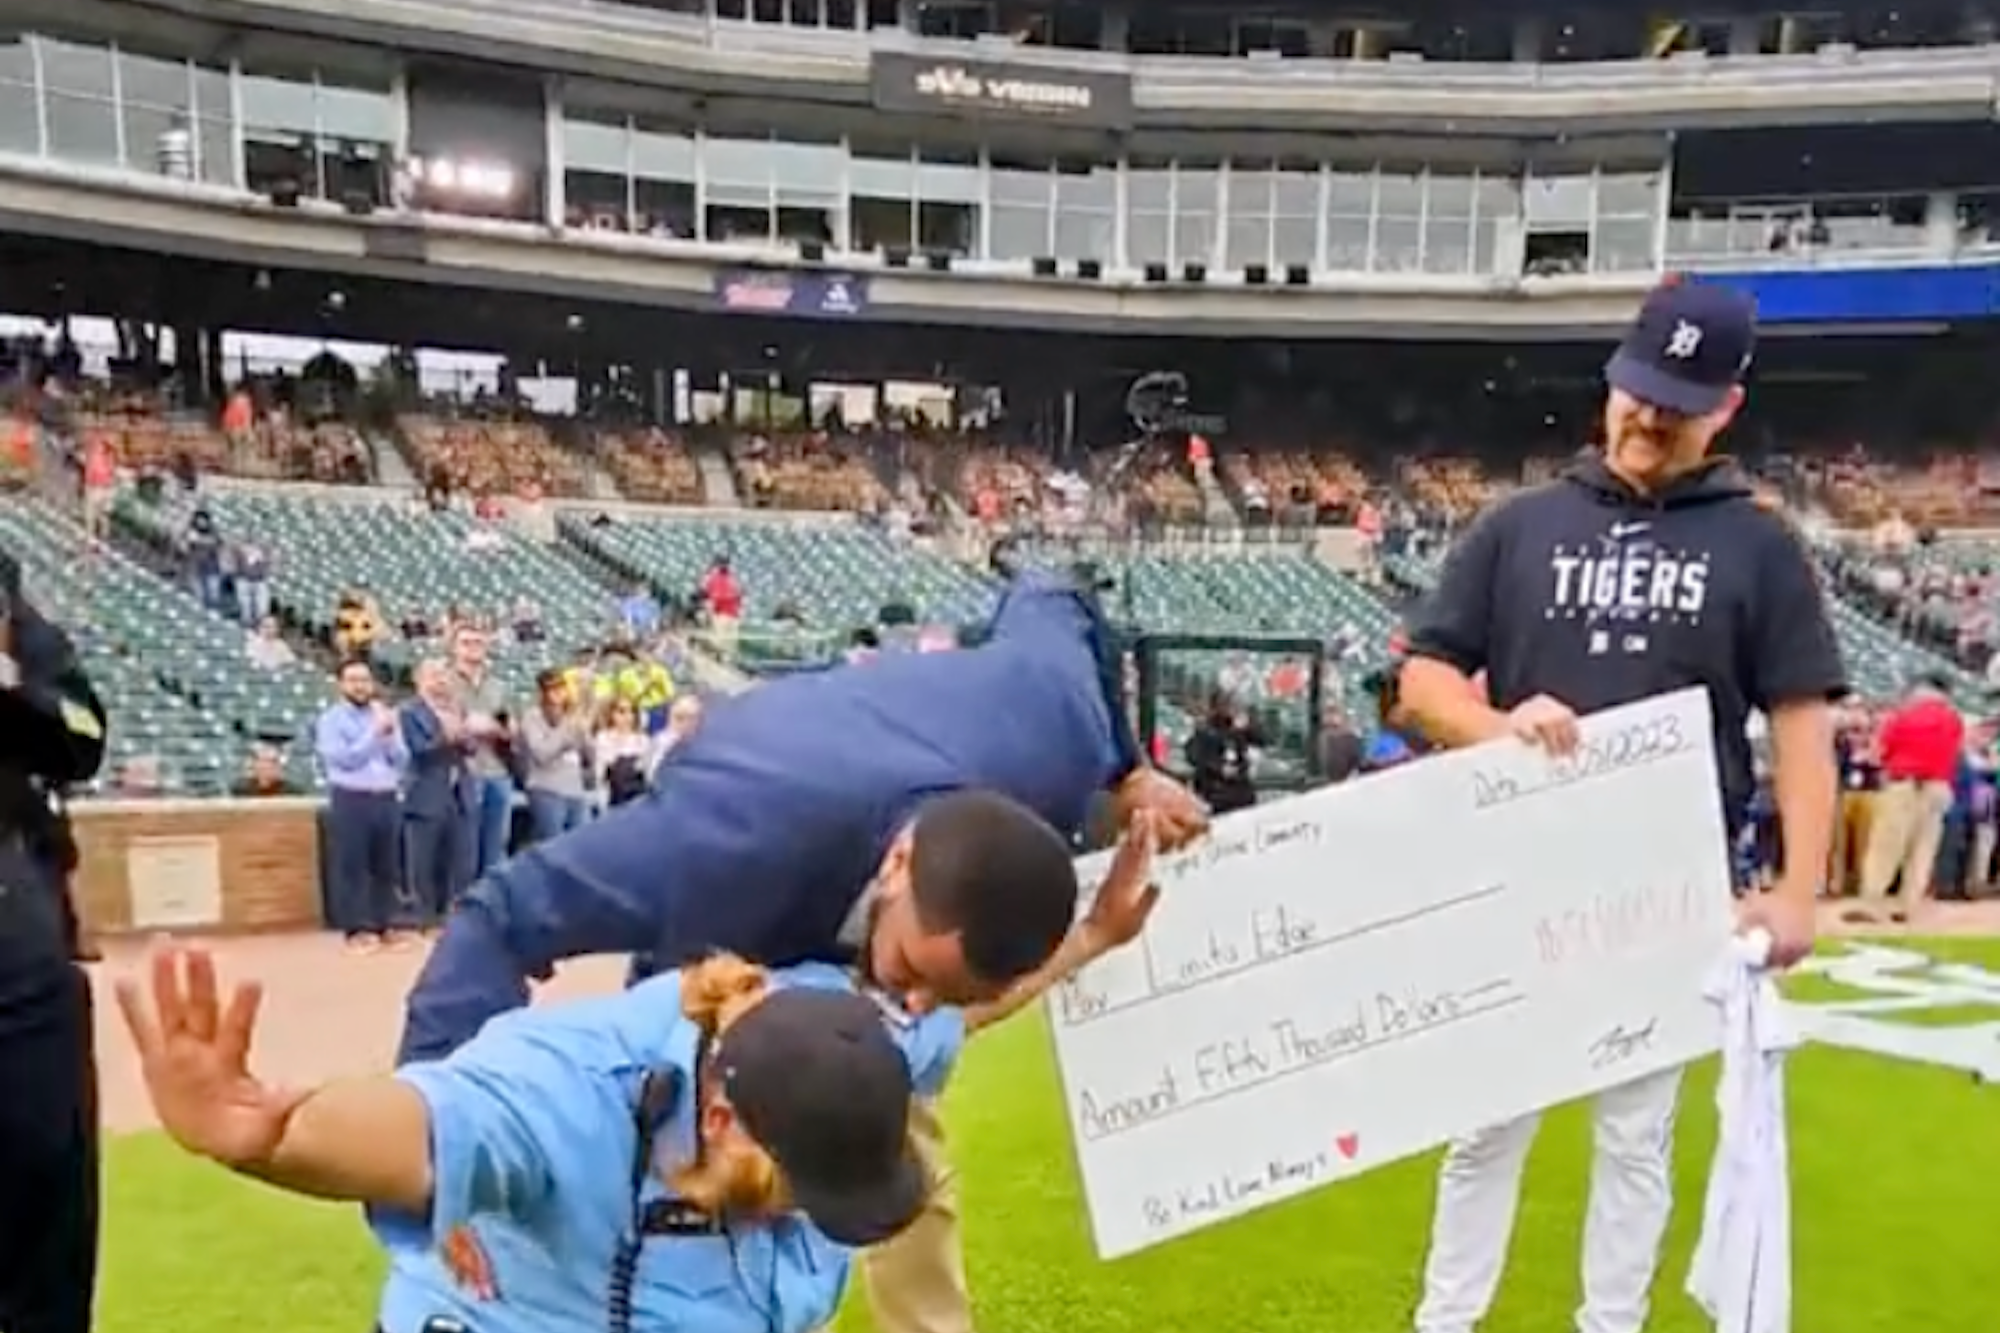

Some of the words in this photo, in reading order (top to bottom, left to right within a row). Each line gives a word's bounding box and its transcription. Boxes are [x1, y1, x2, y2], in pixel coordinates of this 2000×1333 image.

[1551, 557, 1708, 613] TIGERS
[1081, 1064, 1178, 1136] Amount
[1195, 1039, 1270, 1090] Fifty
[1271, 1000, 1367, 1064] Thousand
[1376, 982, 1461, 1033] Dollars
[1176, 1183, 1220, 1215] Kind
